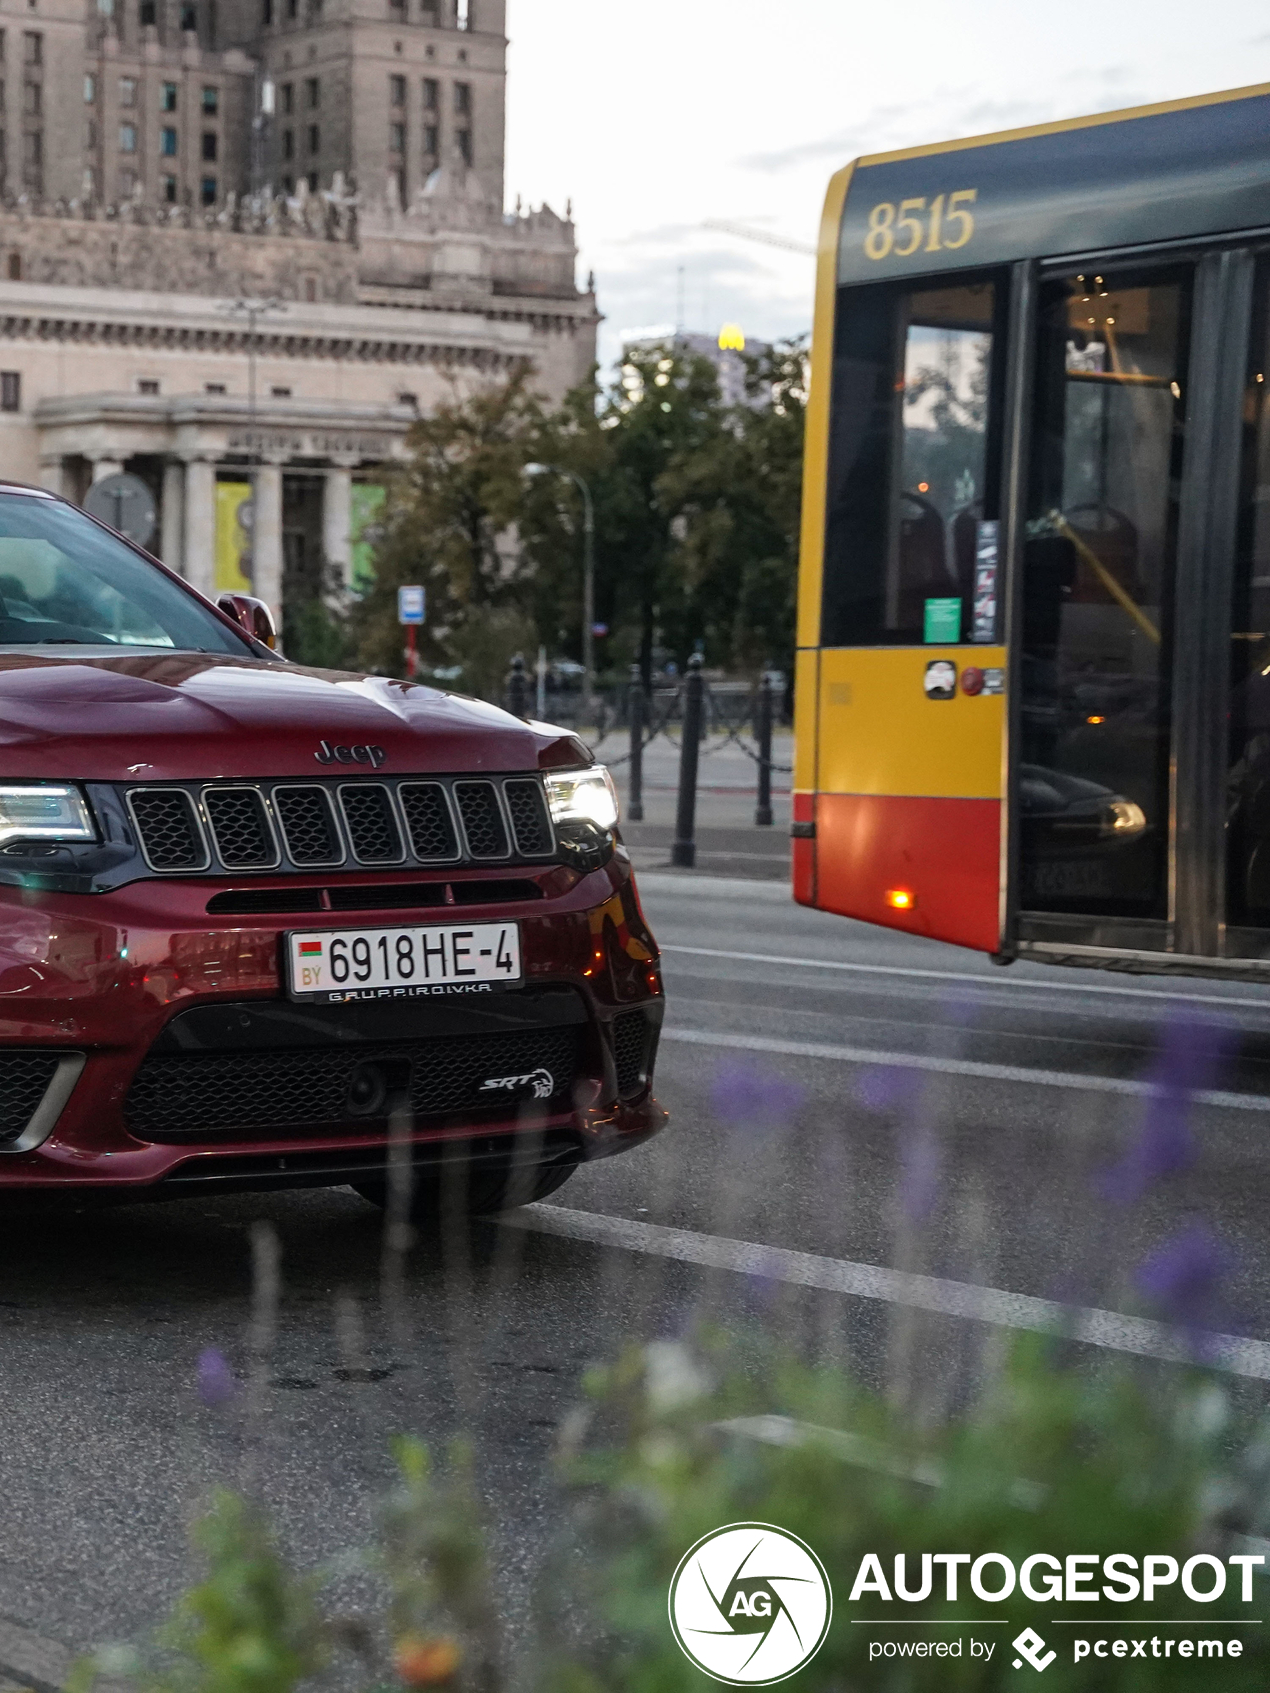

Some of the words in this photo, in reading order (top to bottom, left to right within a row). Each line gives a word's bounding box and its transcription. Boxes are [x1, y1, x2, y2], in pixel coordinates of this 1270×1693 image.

[864, 188, 978, 260] 8515
[314, 739, 387, 769] Jeep
[302, 967, 321, 986] BY
[479, 1074, 537, 1090] SRT
